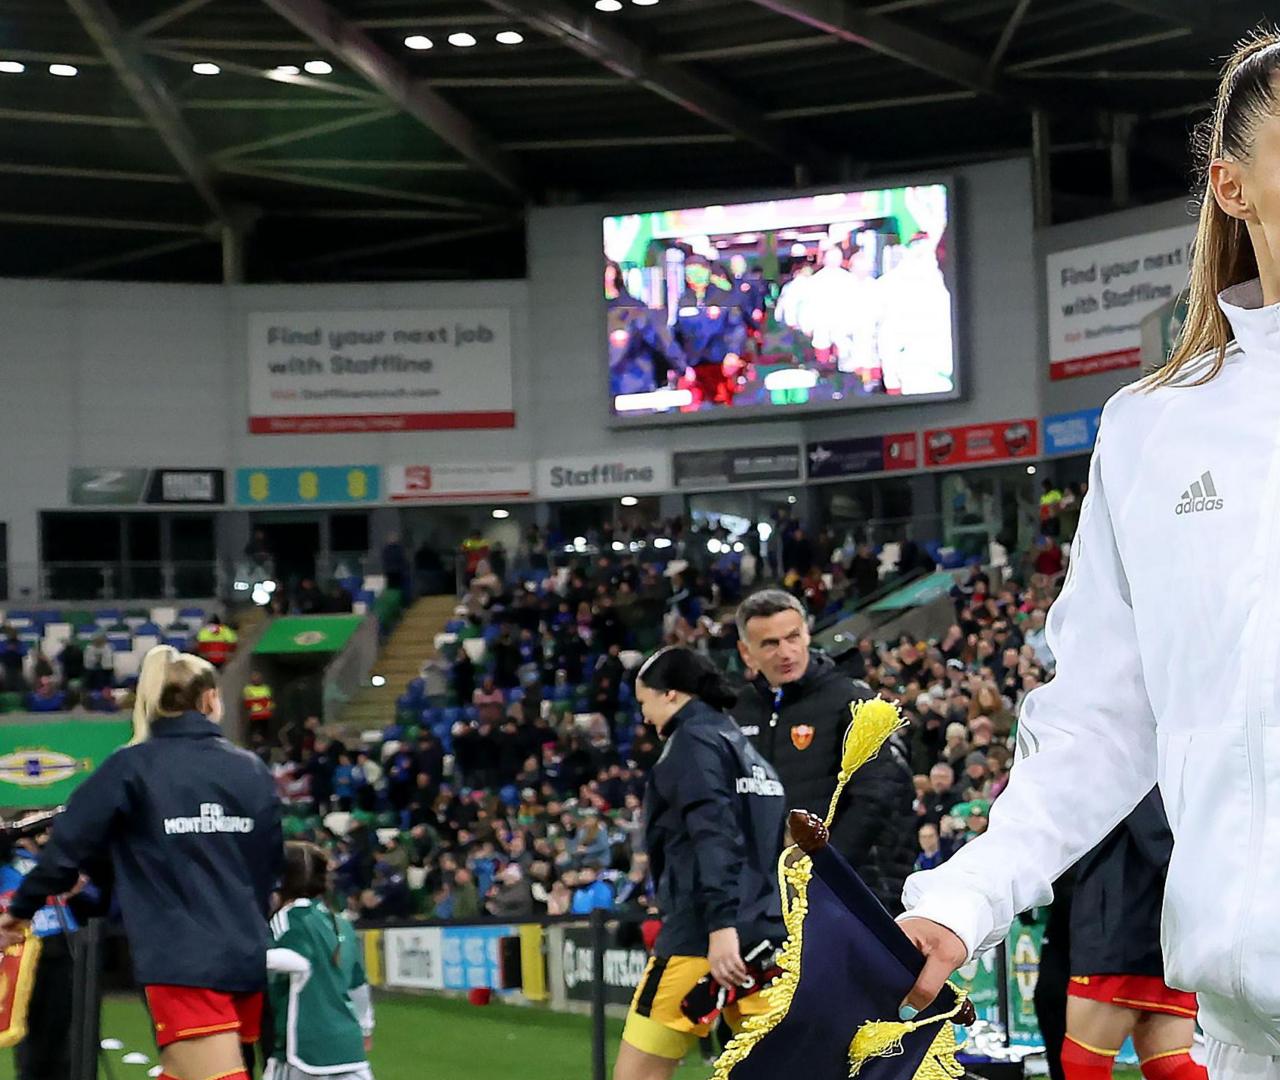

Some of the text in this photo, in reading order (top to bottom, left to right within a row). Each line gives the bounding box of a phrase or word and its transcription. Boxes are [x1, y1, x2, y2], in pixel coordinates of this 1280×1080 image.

[1061, 248, 1183, 287] Find your next
[1062, 282, 1172, 317] with Staffline
[267, 322, 494, 350] Find your next job
[268, 354, 433, 375] with Staffline
[550, 462, 654, 488] Staffline
[1175, 497, 1223, 515] adidas
